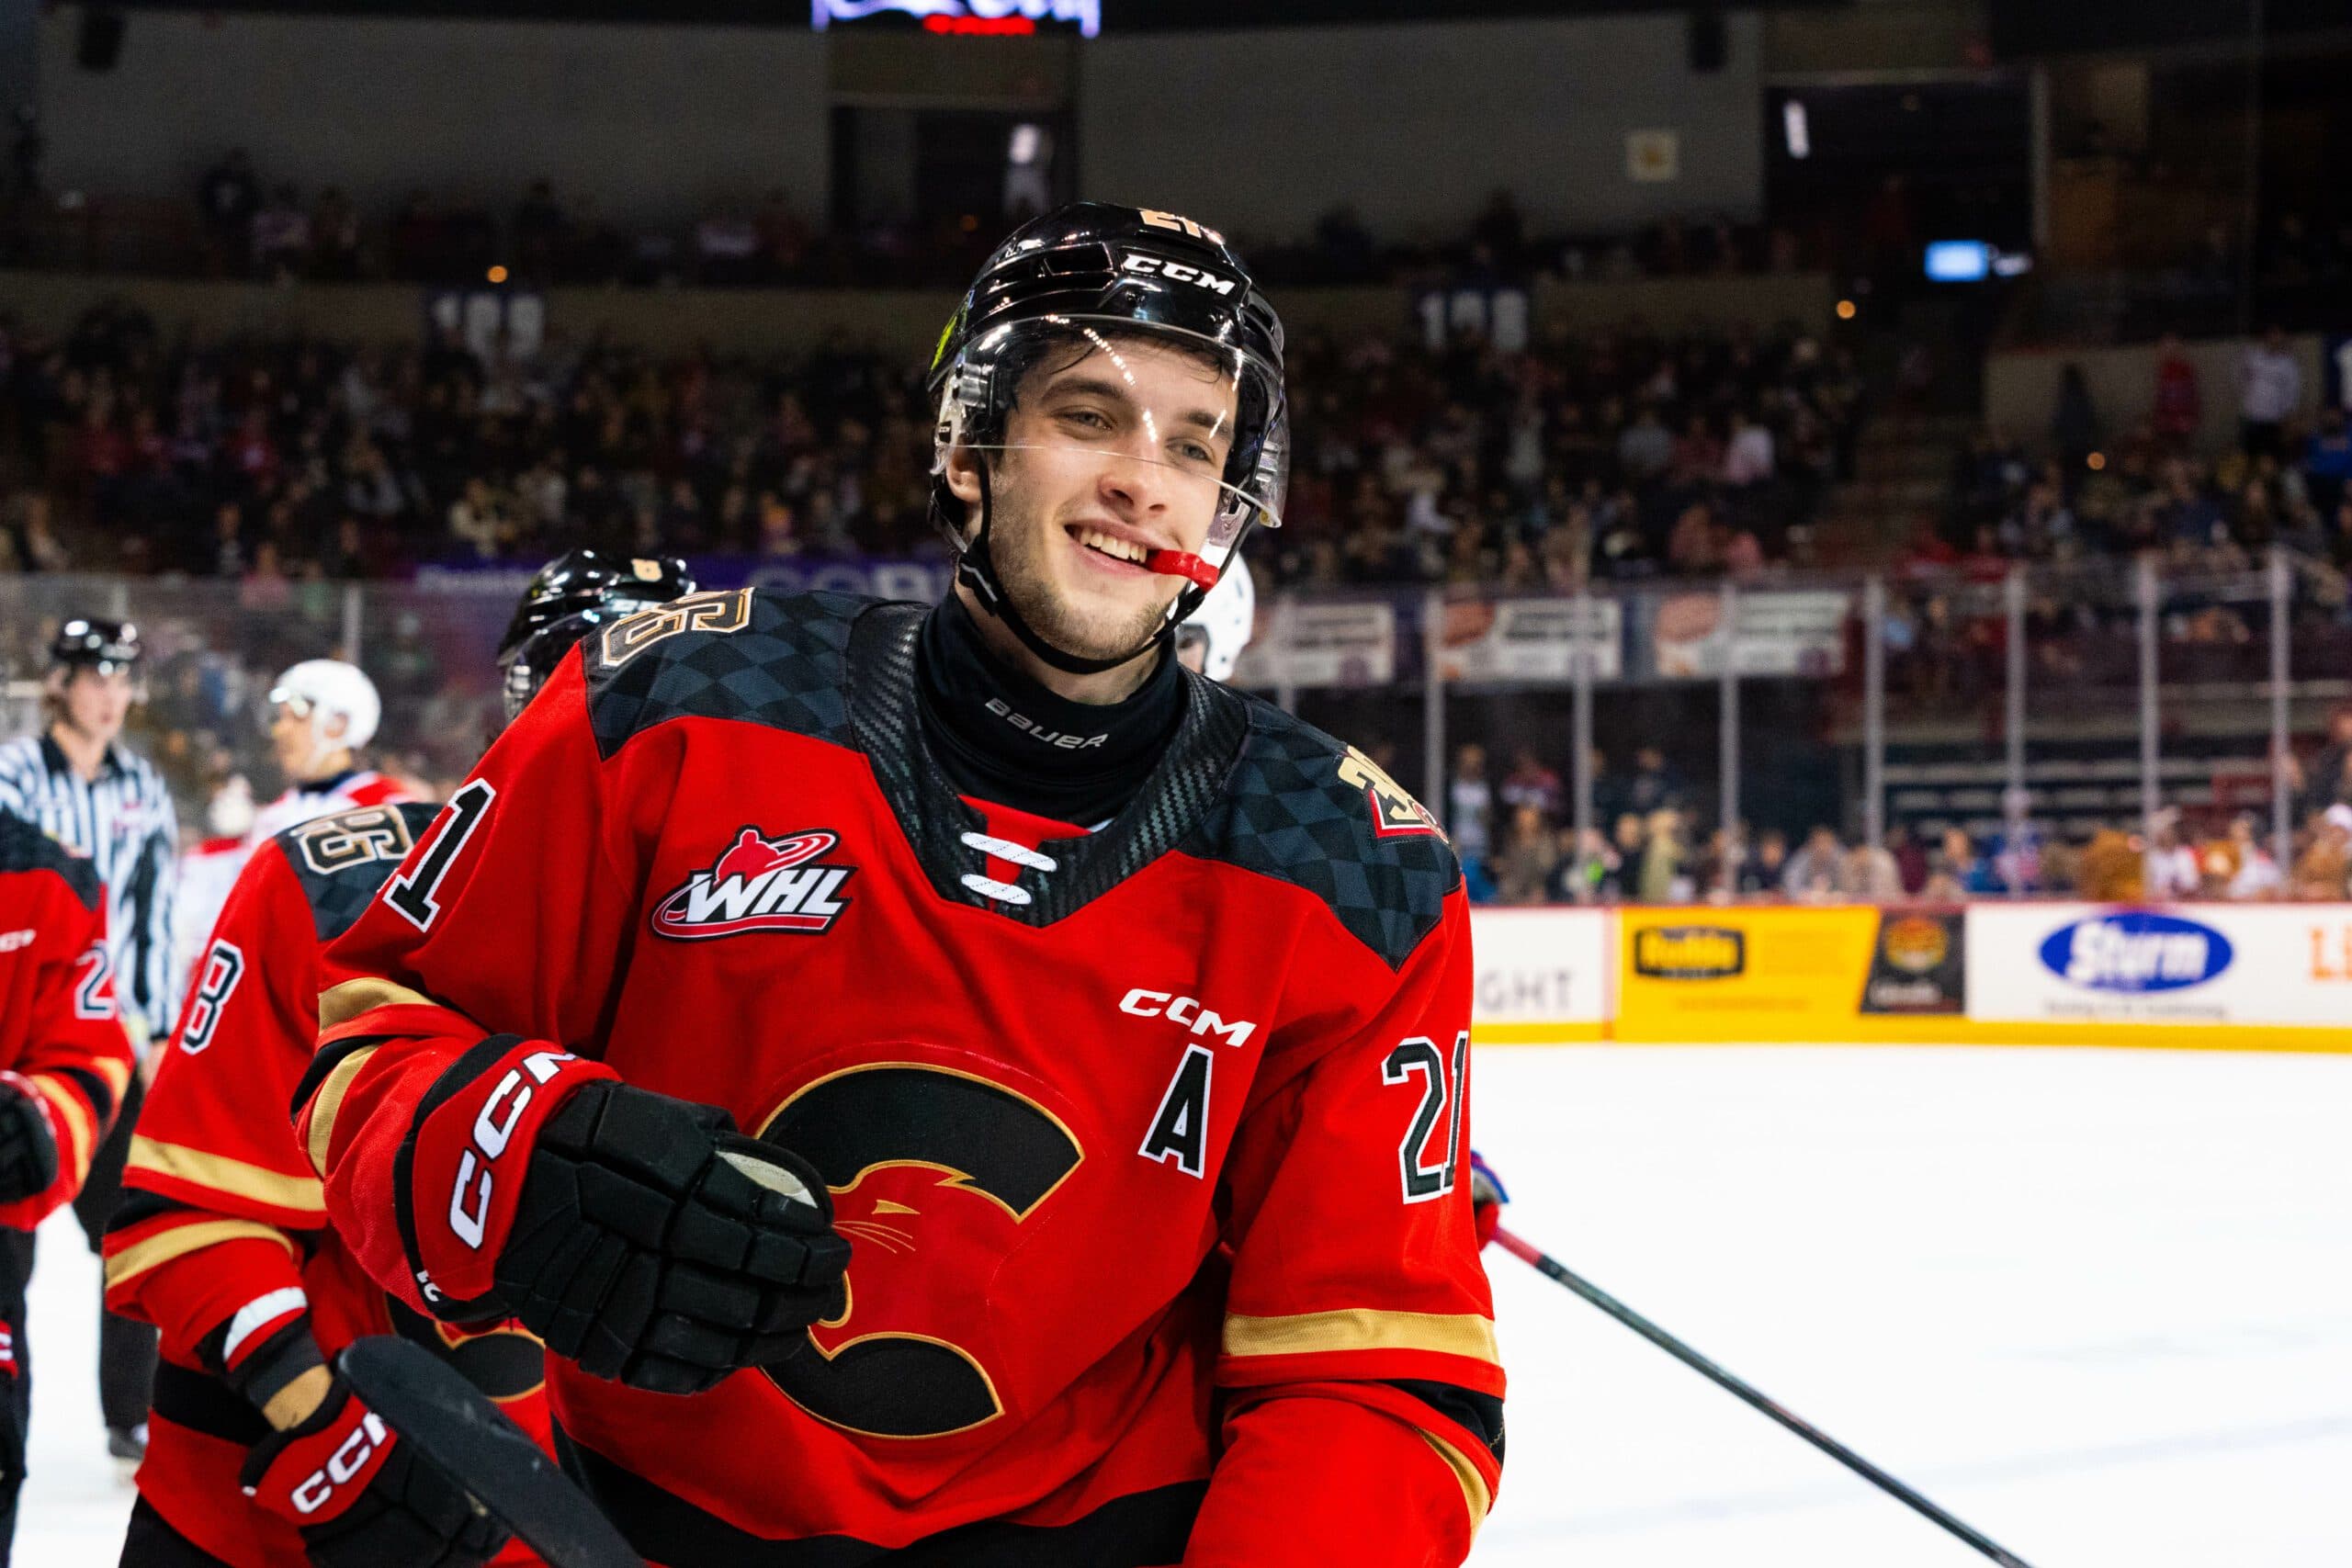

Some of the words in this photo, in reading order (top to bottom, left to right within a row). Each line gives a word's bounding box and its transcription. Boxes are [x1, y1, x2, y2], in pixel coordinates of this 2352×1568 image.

[1122, 254, 1237, 296] CCM
[377, 777, 497, 933] 1
[685, 868, 849, 923] WHL
[179, 937, 244, 1055] 8
[1118, 988, 1257, 1047] CCM
[1137, 1043, 1215, 1180] A
[1381, 1031, 1469, 1205] 21
